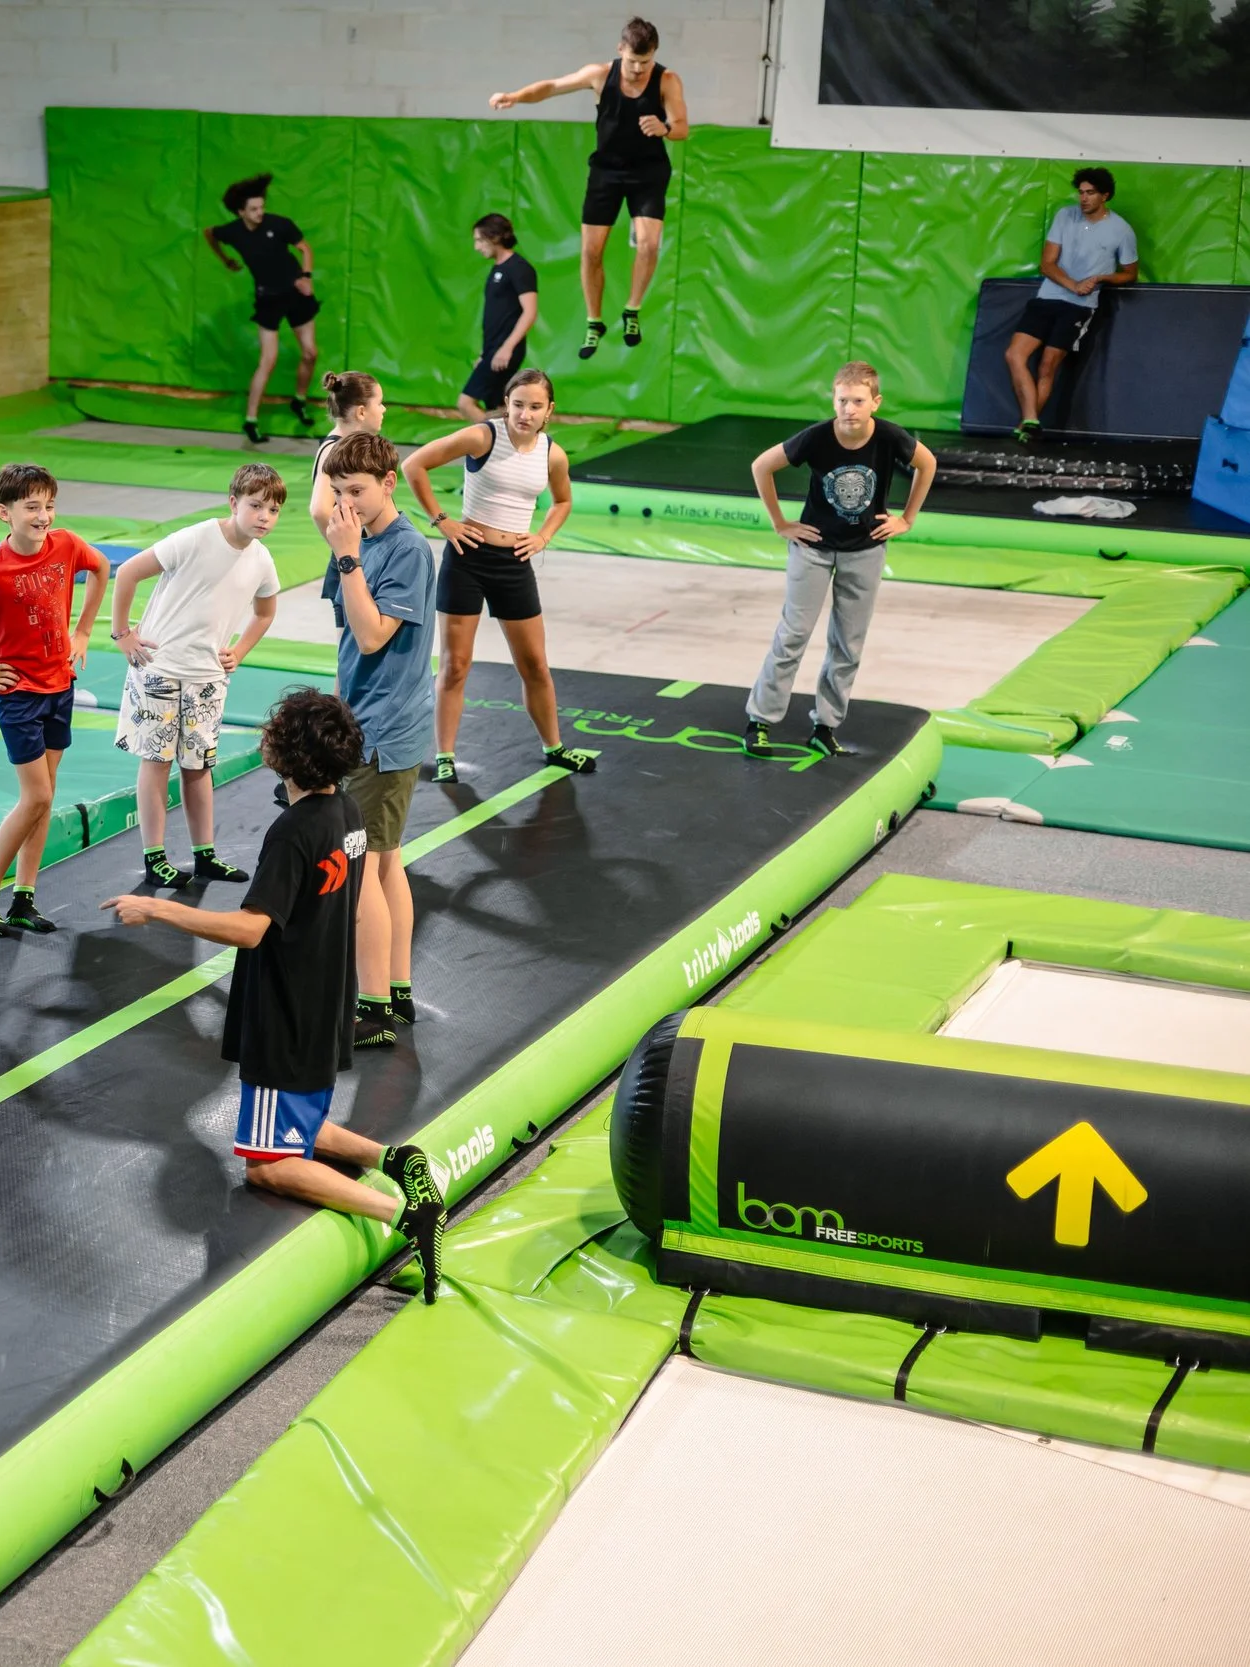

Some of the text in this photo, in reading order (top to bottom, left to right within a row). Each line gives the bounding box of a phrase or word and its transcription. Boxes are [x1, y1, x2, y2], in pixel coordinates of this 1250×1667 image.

[663, 504, 760, 525] AirTrack Factory
[682, 910, 761, 989] trick tools
[446, 1124, 496, 1182] tools
